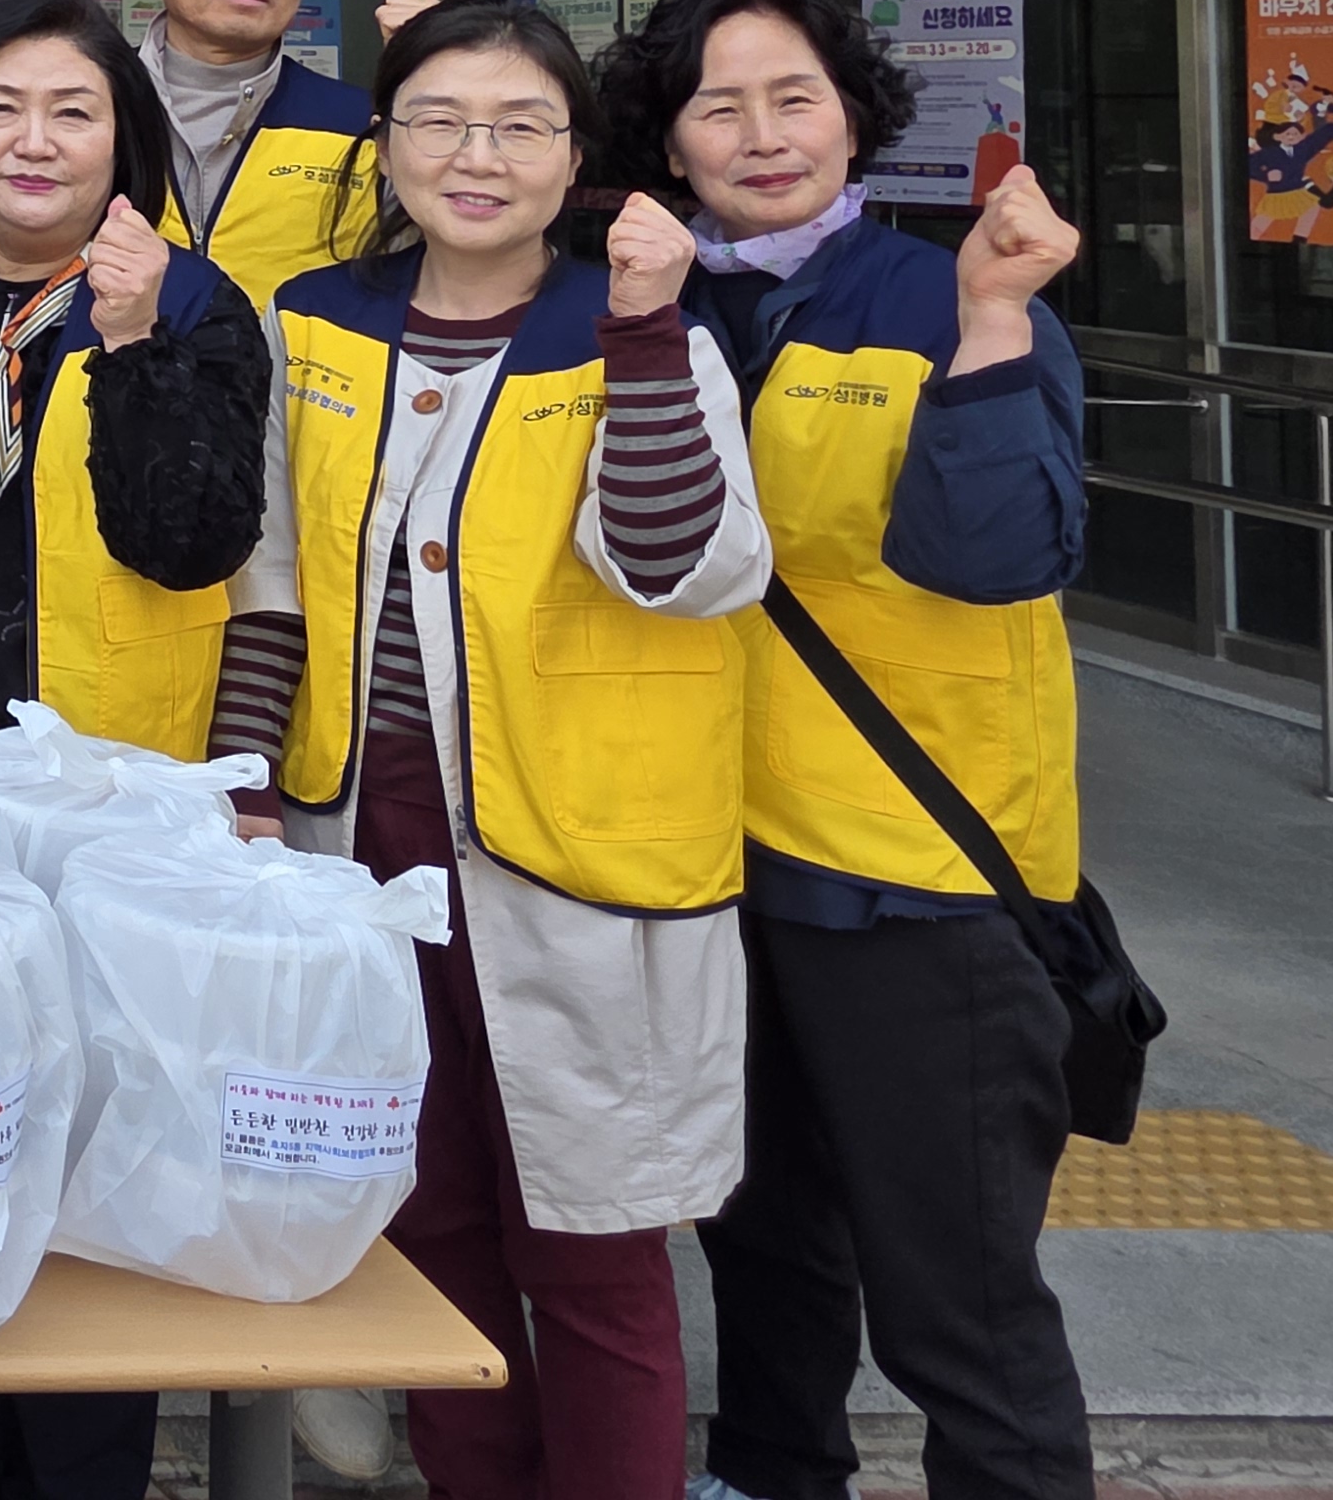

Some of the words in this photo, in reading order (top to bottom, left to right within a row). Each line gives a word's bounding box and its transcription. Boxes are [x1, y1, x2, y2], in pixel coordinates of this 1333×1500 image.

[922, 5, 1013, 30] 신청하세요
[231, 1109, 277, 1131] 든든한
[285, 1117, 330, 1137] 밑반찬
[342, 1123, 378, 1141] 건강한
[384, 1122, 405, 1138] 하루
